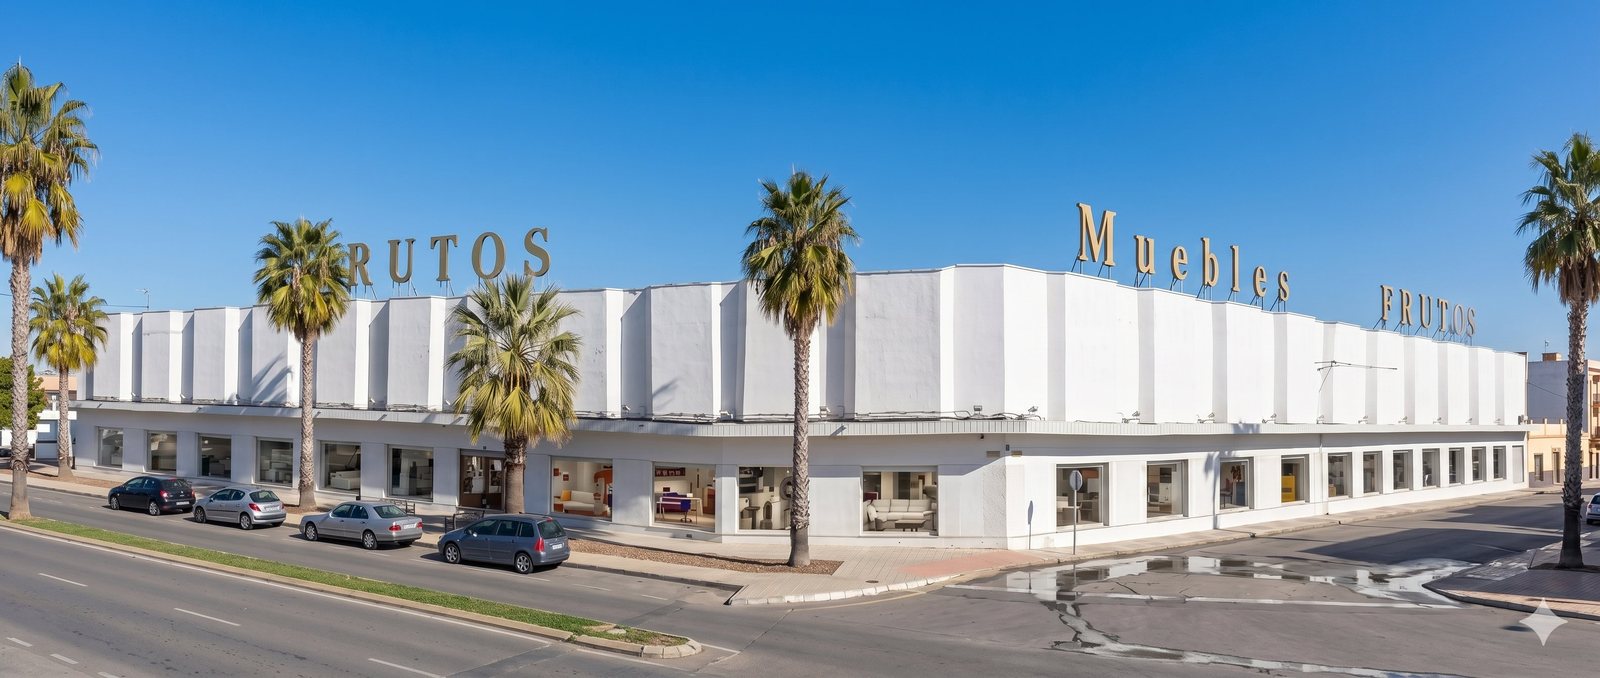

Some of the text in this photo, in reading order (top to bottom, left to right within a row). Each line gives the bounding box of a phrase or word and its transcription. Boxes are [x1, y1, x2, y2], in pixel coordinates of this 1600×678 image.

[347, 227, 551, 286] RUTOS
[1076, 202, 1476, 337] Muebles FRUTOS
